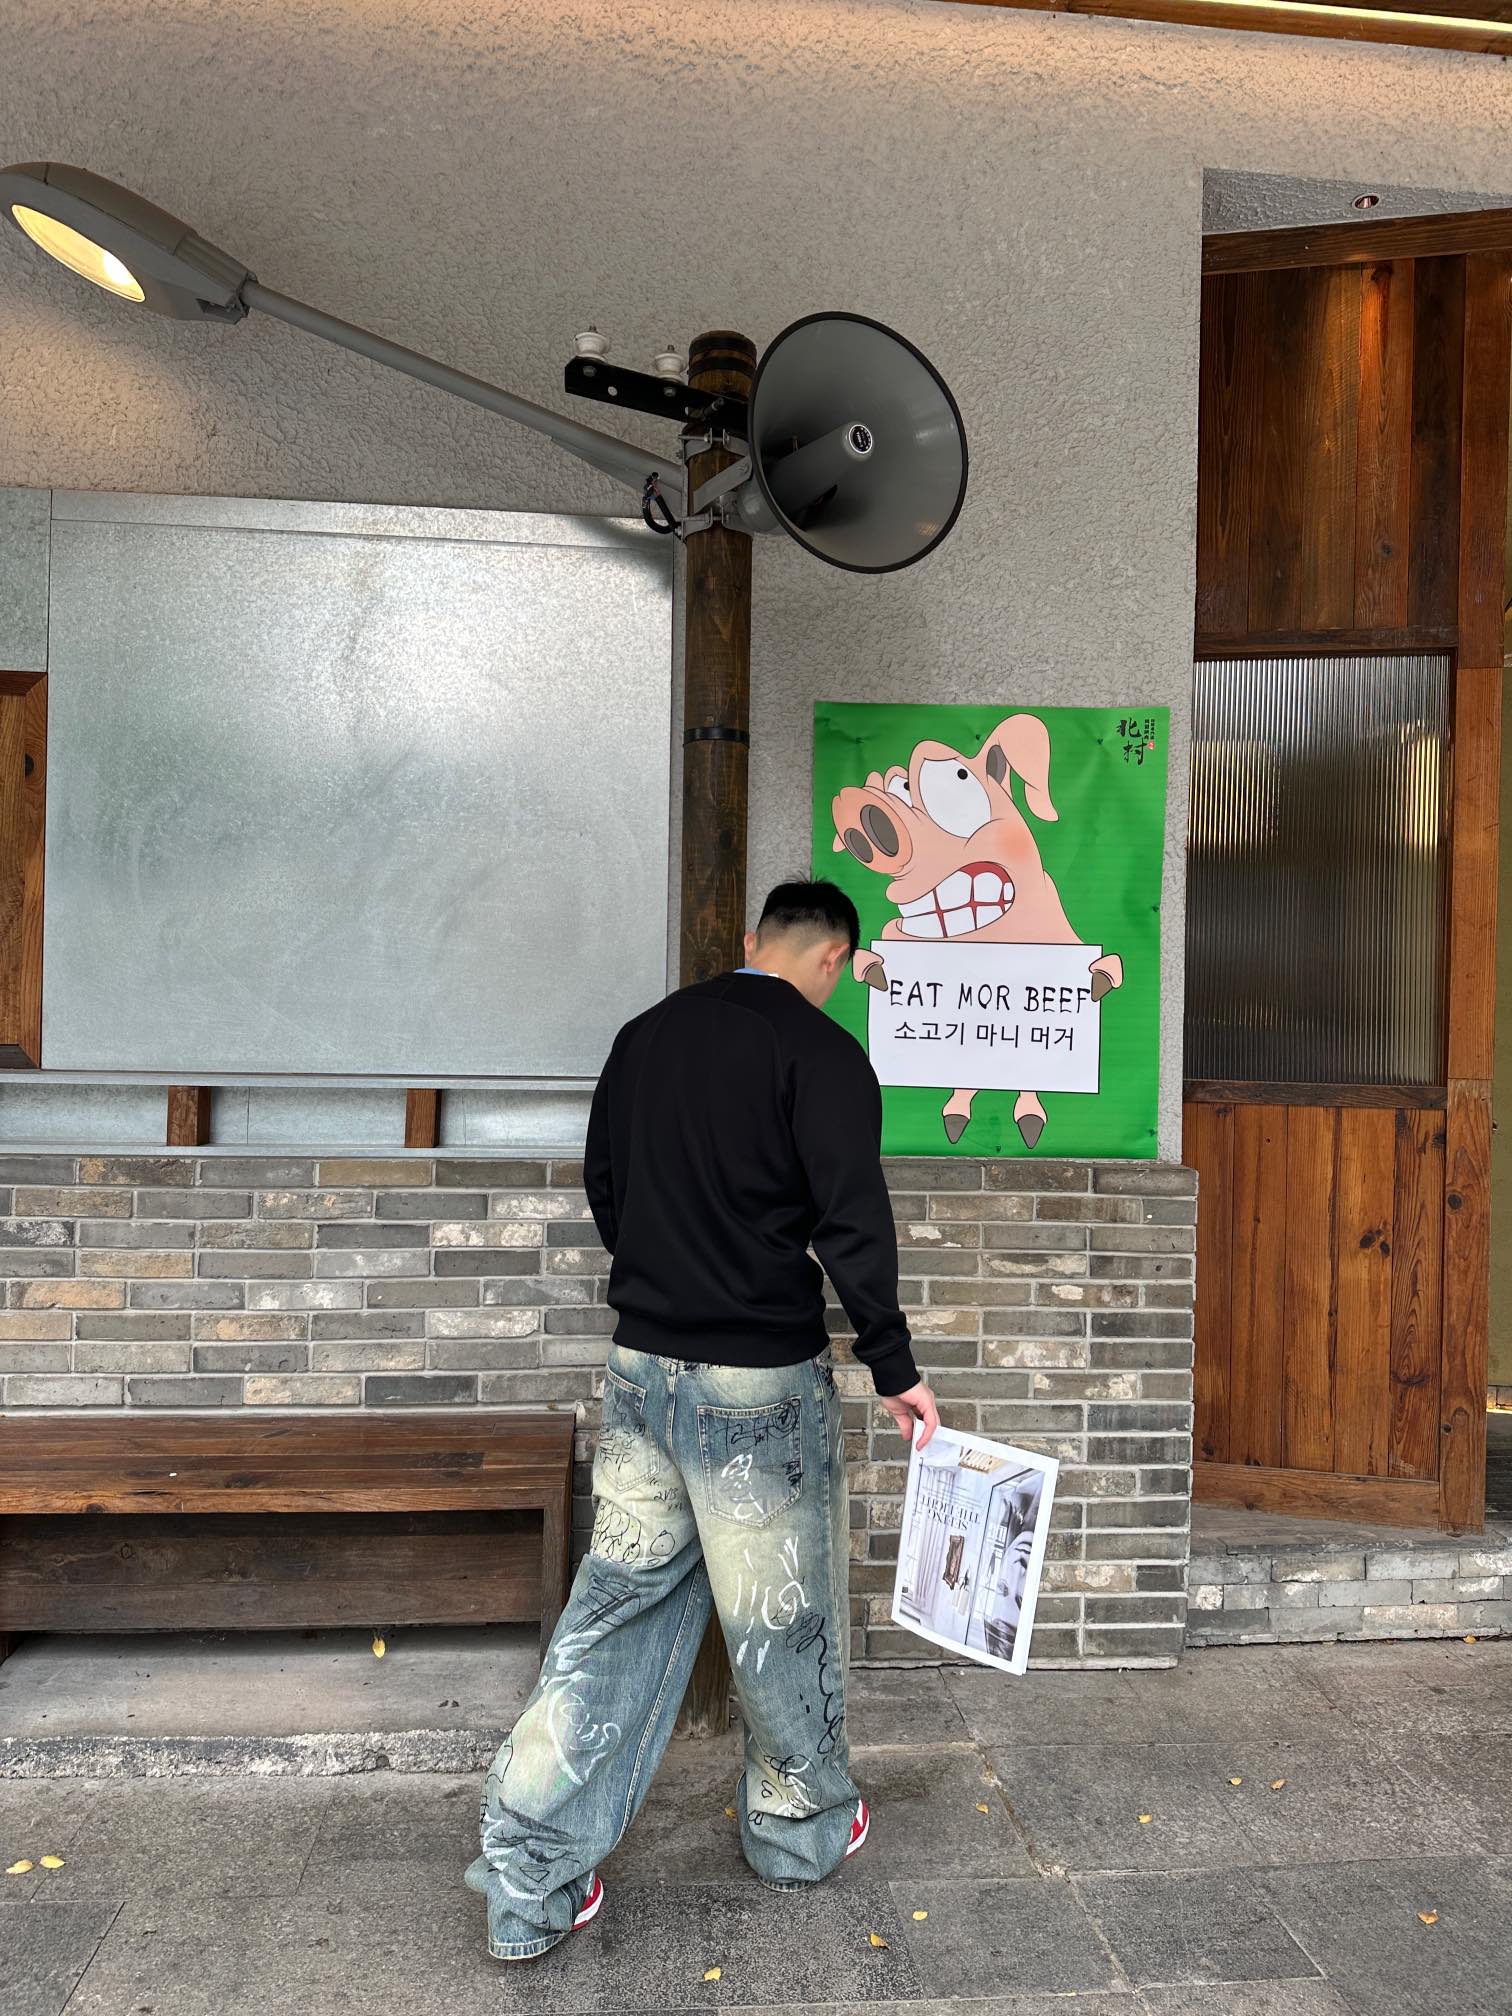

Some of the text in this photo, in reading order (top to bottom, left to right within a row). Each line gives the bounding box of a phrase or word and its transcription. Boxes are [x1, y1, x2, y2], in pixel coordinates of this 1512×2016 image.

[1116, 716, 1148, 765] 北村
[890, 979, 1091, 1014] EAT MOR BEEF
[894, 1021, 1074, 1052] 소고기 마니 머거
